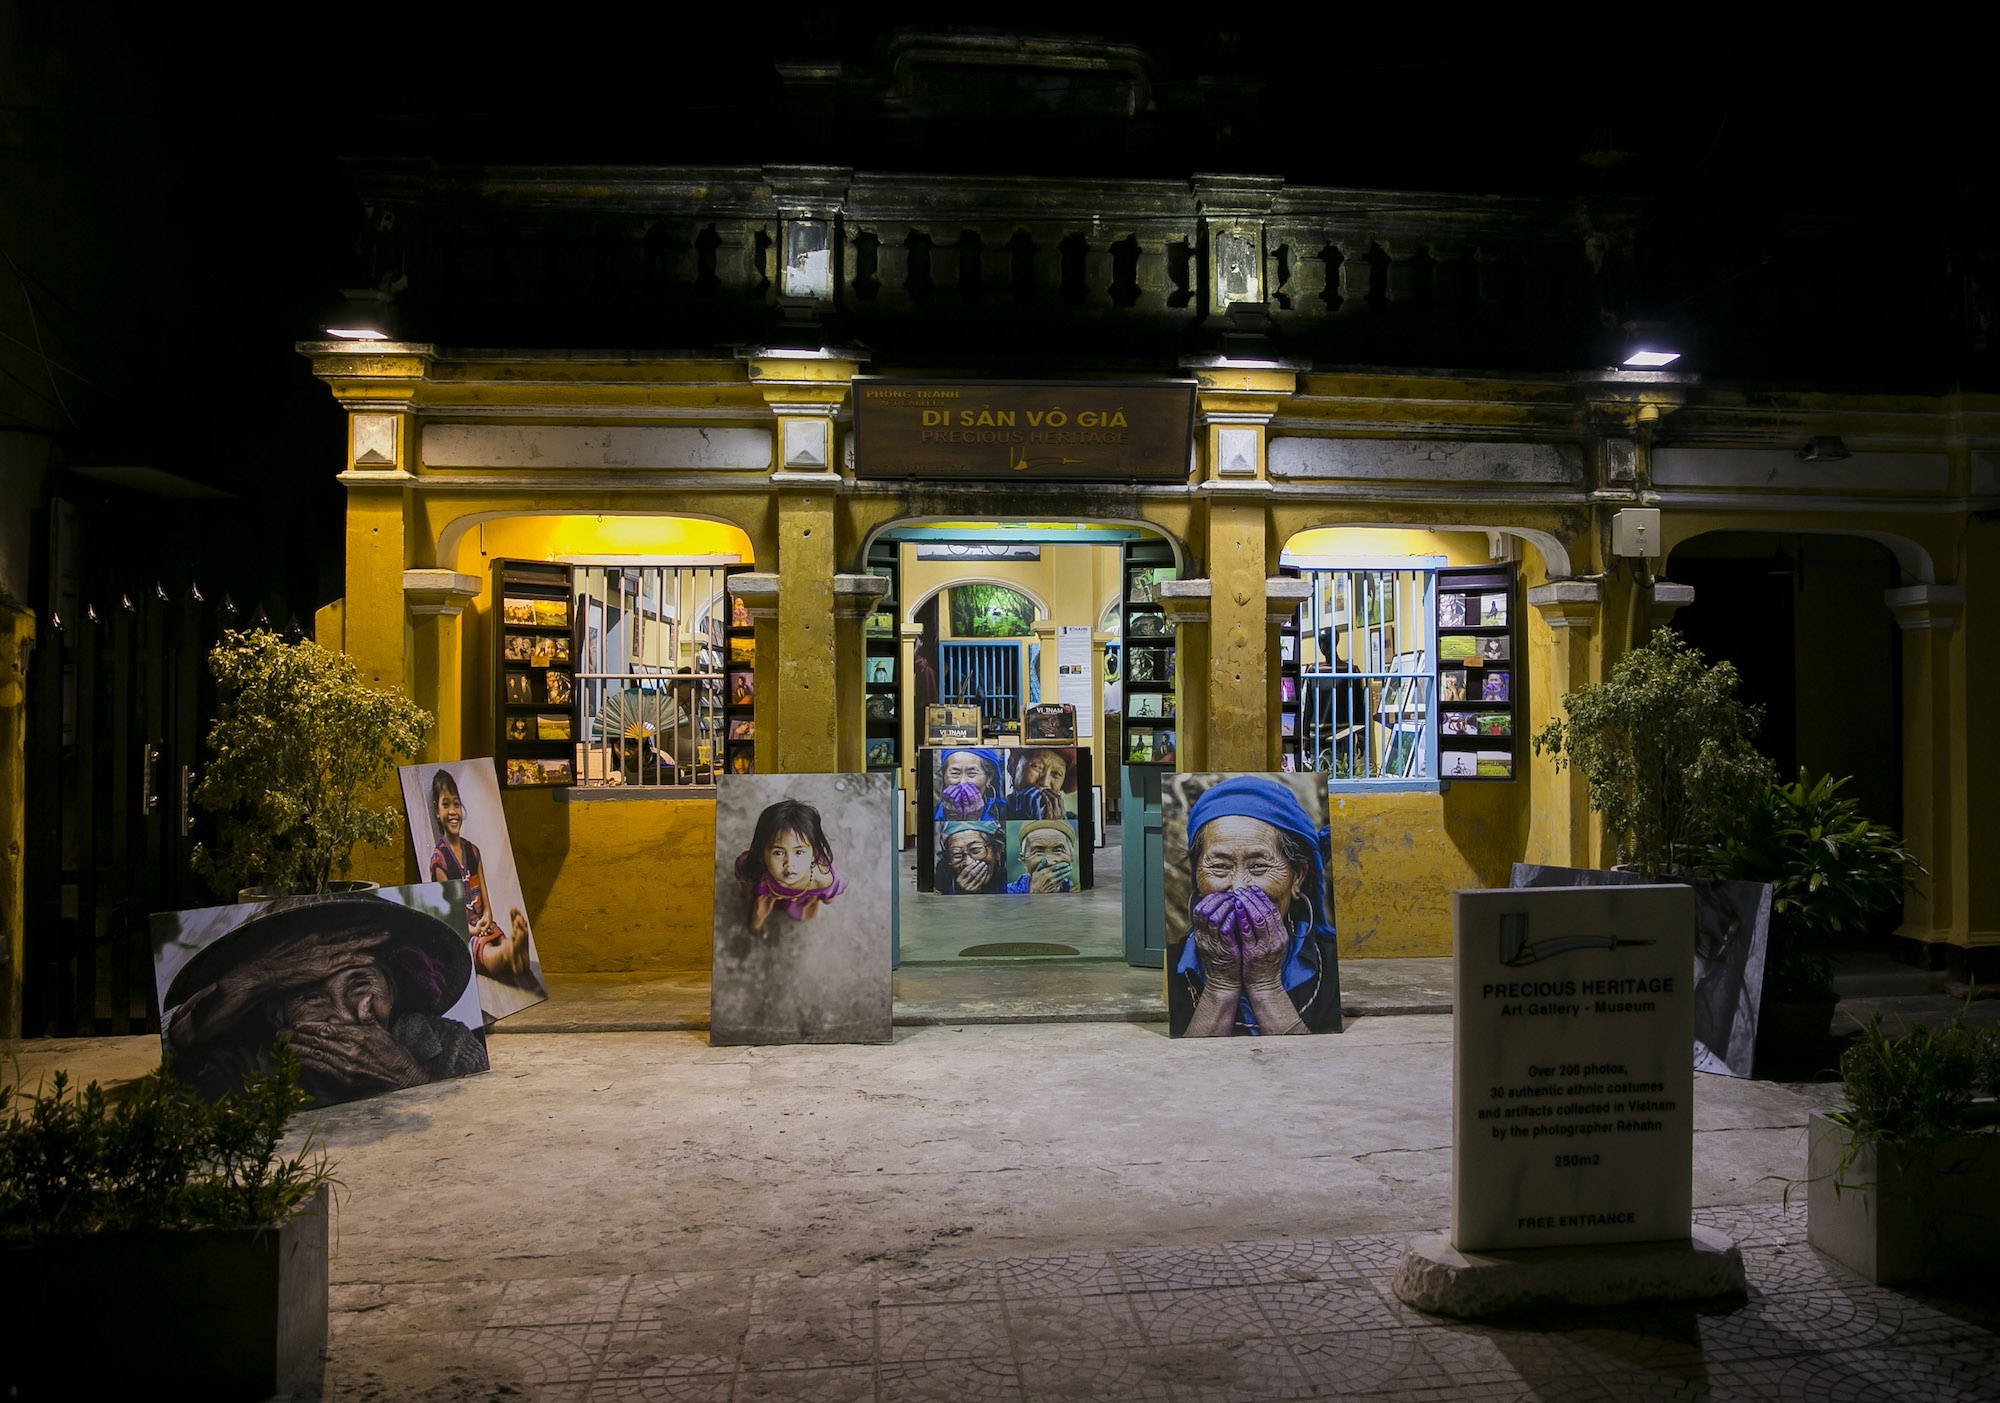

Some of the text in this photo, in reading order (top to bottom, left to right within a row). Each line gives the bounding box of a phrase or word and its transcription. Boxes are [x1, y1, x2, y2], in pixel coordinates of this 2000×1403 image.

[915, 390, 960, 400] TRANH
[921, 404, 1129, 428] DI SẢN VÔ GIÁ
[921, 430, 1129, 446] PRECIOUS HERITAGE
[1482, 977, 1674, 999] PRECIOUS HERITAGE
[1500, 1004, 1524, 1017] Art
[1527, 1003, 1581, 1018] Gallery
[1594, 1000, 1656, 1014] Museum
[1527, 1063, 1628, 1079] Over 200 photos,
[1489, 1081, 1665, 1100] 30 authentic ethnic costumes
[1478, 1099, 1677, 1120] and artifacts collected in Vietnam
[1491, 1126, 1507, 1142] by
[1510, 1125, 1530, 1138] the
[1532, 1121, 1614, 1141] photographer
[1554, 1153, 1601, 1168] 250m2
[1517, 1211, 1636, 1230] FREE ENTRANCE
